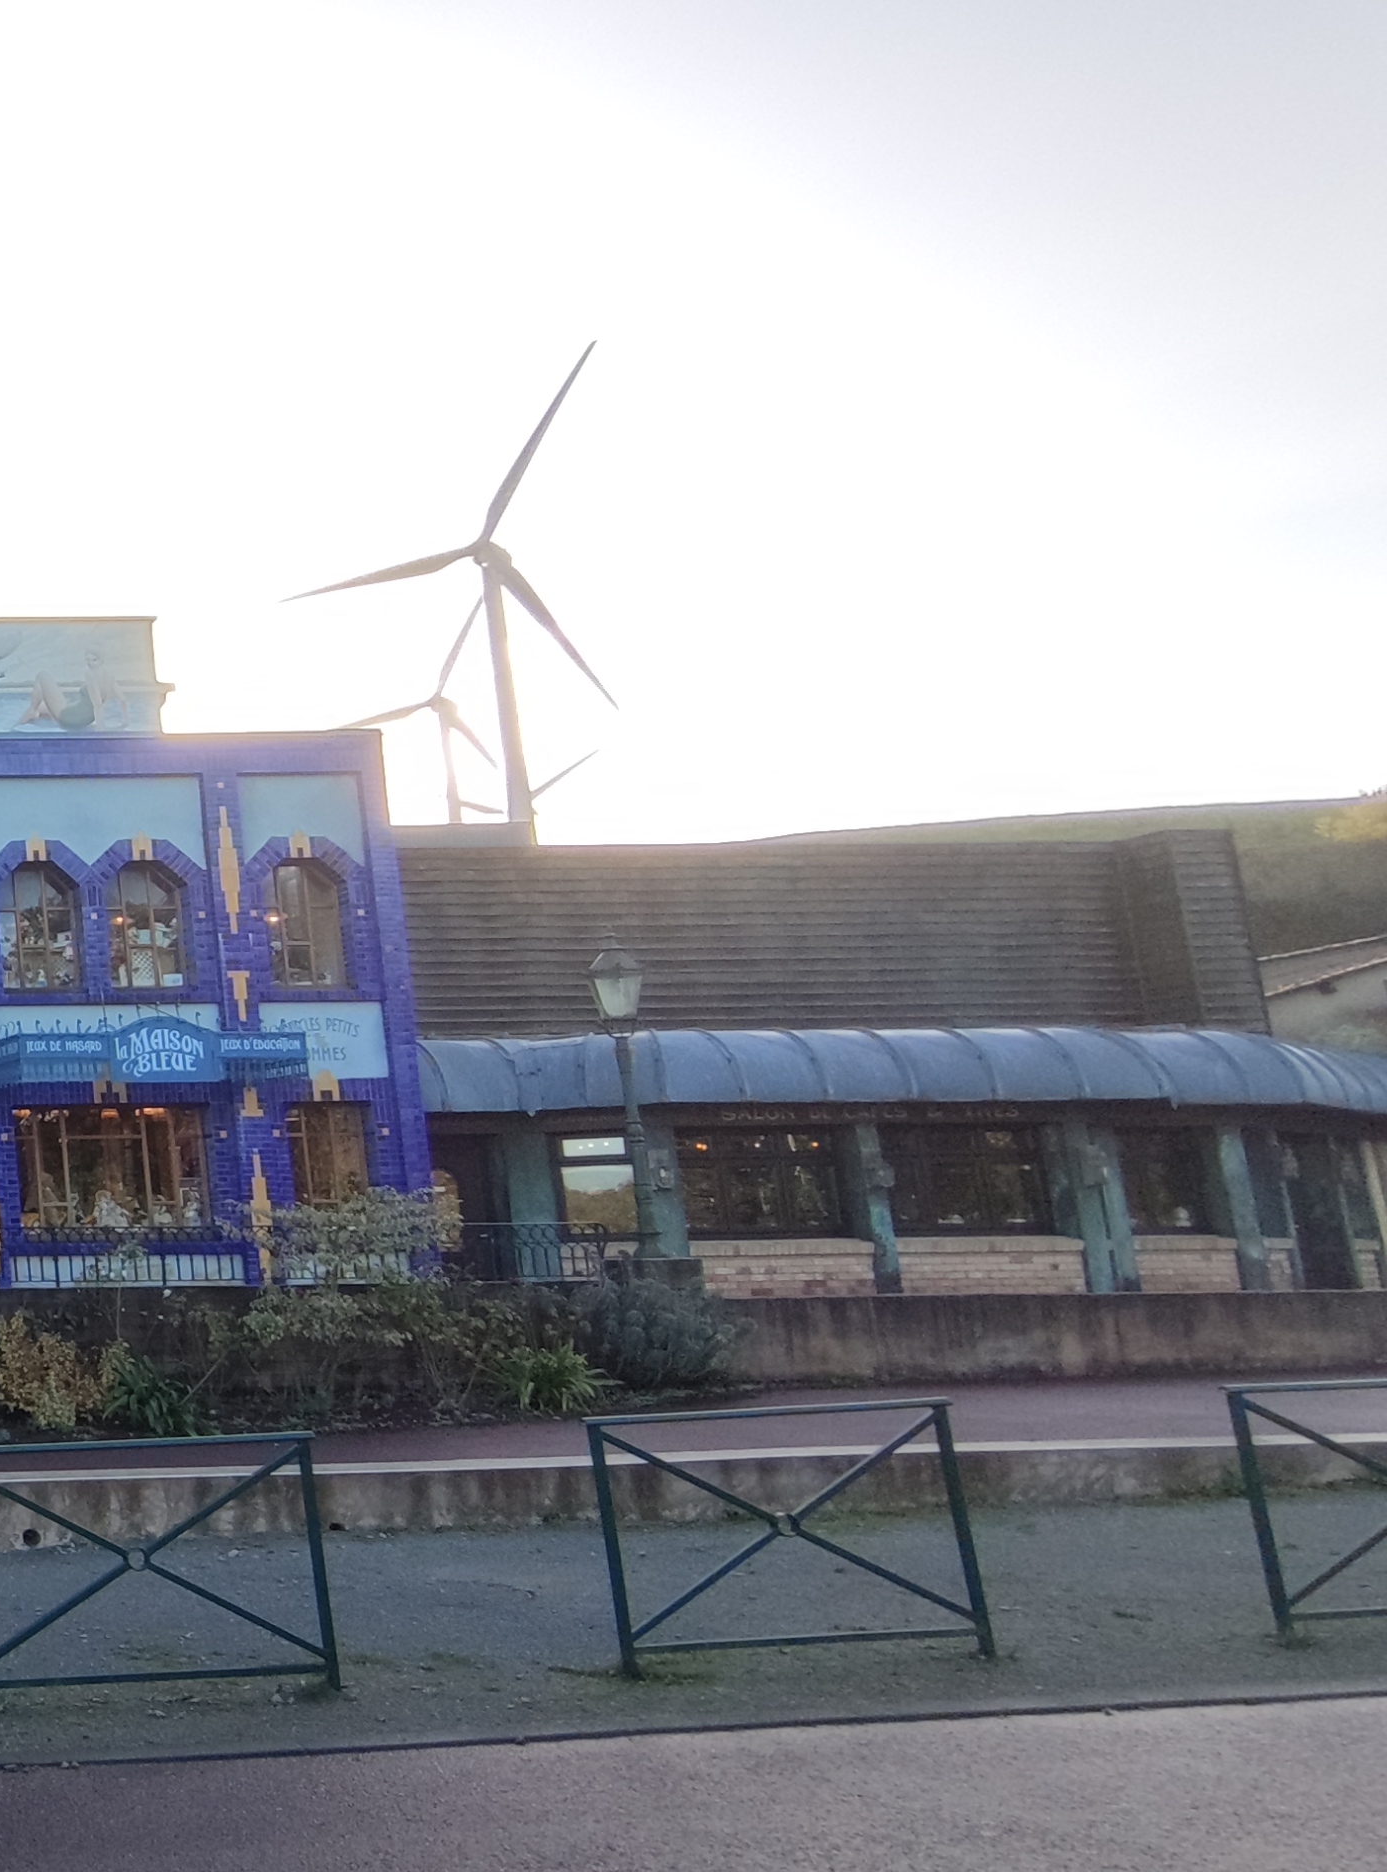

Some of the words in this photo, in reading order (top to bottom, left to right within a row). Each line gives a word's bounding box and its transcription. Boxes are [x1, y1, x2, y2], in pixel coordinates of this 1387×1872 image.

[325, 1017, 360, 1037] PETITS
[26, 1040, 48, 1054] JEUX
[50, 1040, 62, 1052] DE
[65, 1040, 103, 1054] HASARD
[122, 1027, 205, 1073] MAISON
[133, 1051, 197, 1078] BLEUE
